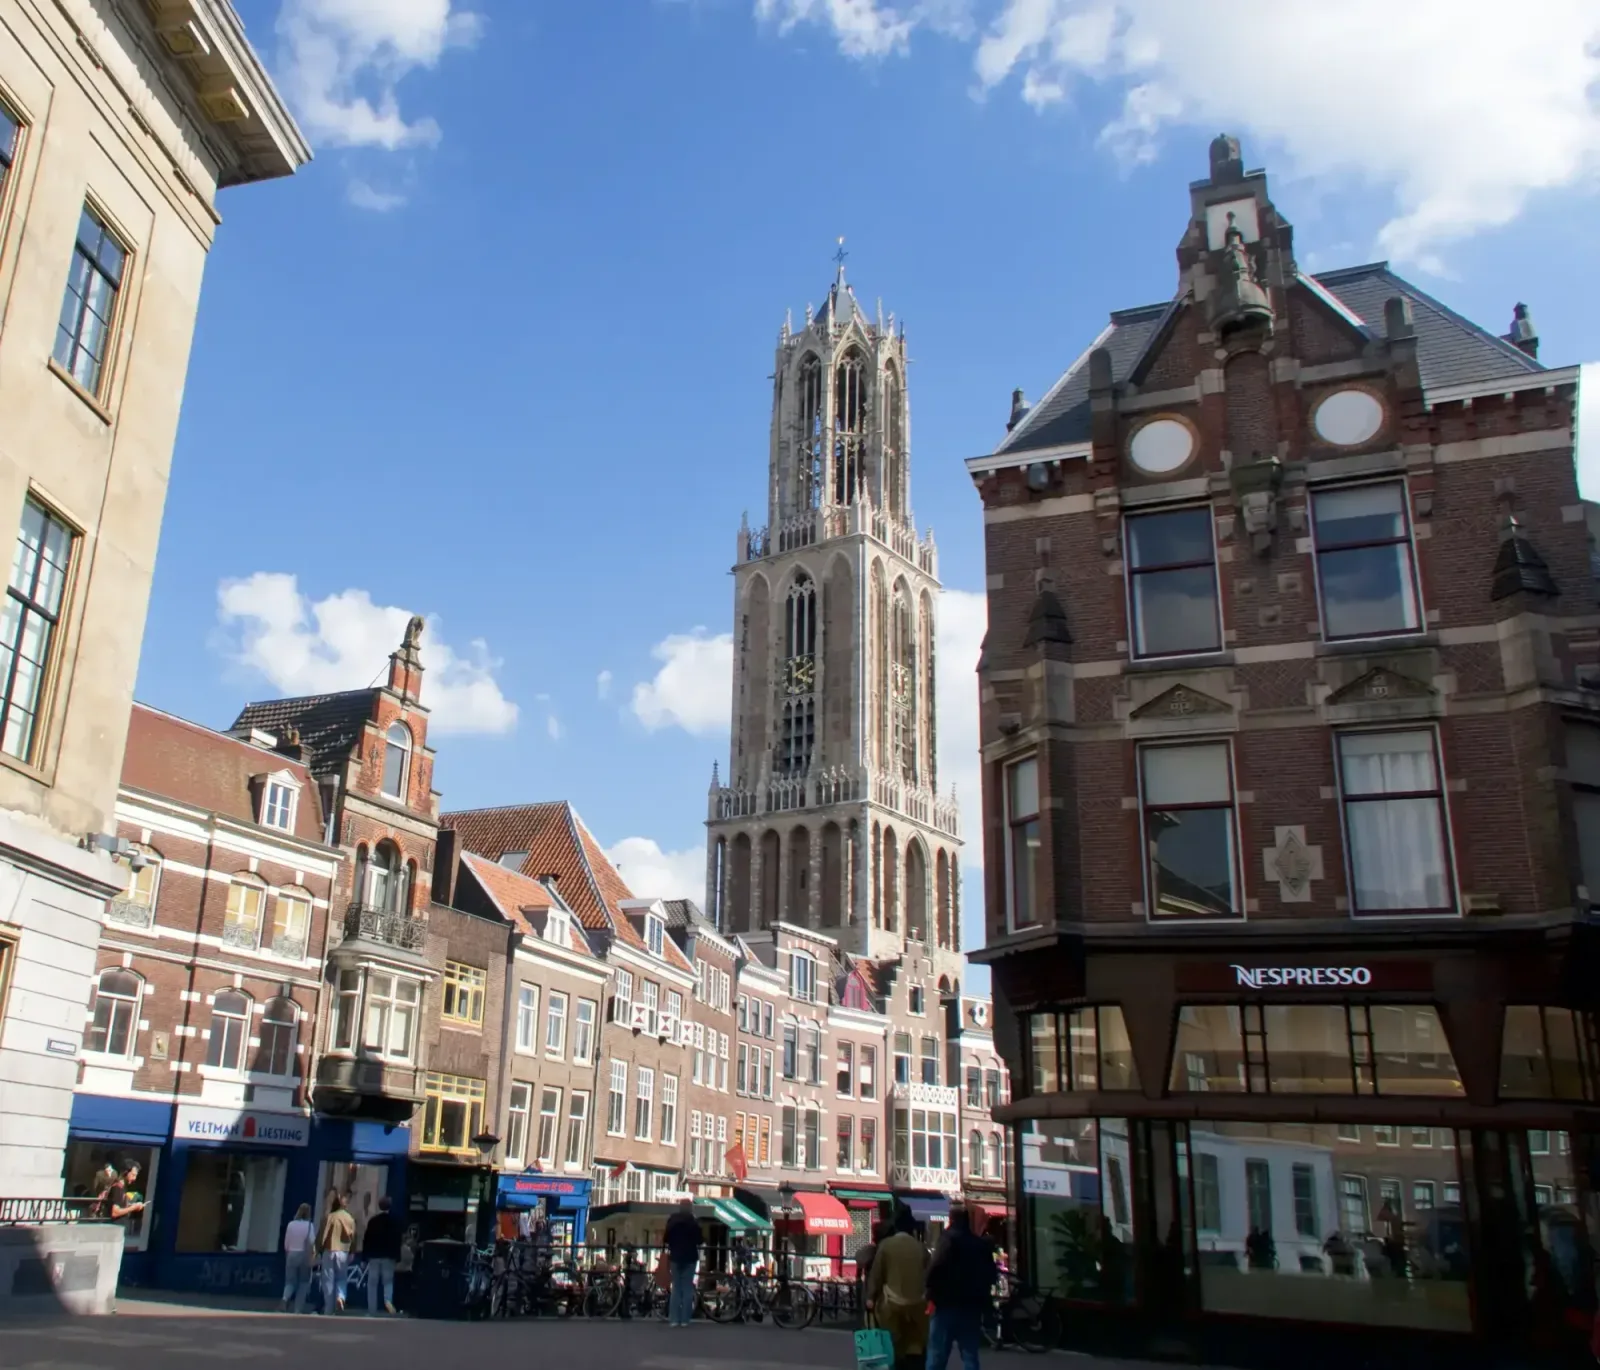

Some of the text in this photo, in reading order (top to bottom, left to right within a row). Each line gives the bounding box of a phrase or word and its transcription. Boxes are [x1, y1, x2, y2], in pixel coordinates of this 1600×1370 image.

[1229, 964, 1372, 988] NESPRESSO
[188, 1120, 303, 1141] VELTMAN LIESTING
